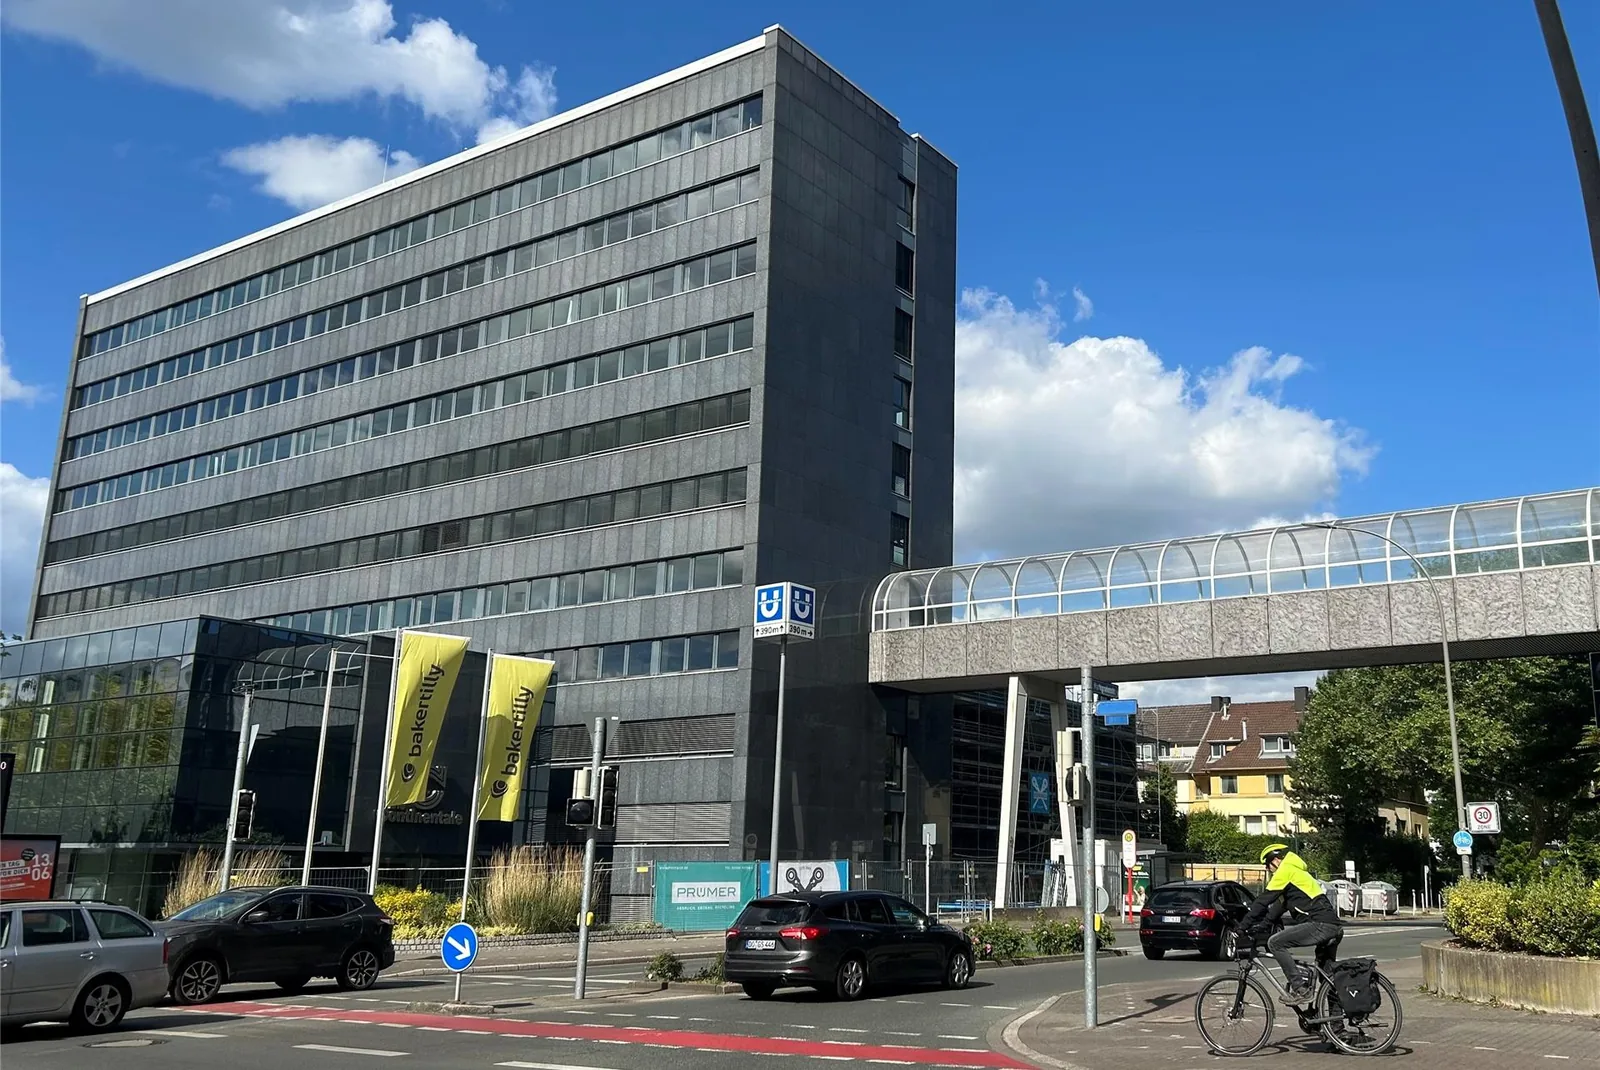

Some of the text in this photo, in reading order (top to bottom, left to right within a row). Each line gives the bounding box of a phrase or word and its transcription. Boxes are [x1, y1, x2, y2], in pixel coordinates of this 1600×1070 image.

[409, 664, 445, 757] bakertilly
[501, 686, 534, 776] bakertilly
[1477, 811, 1488, 820] 30
